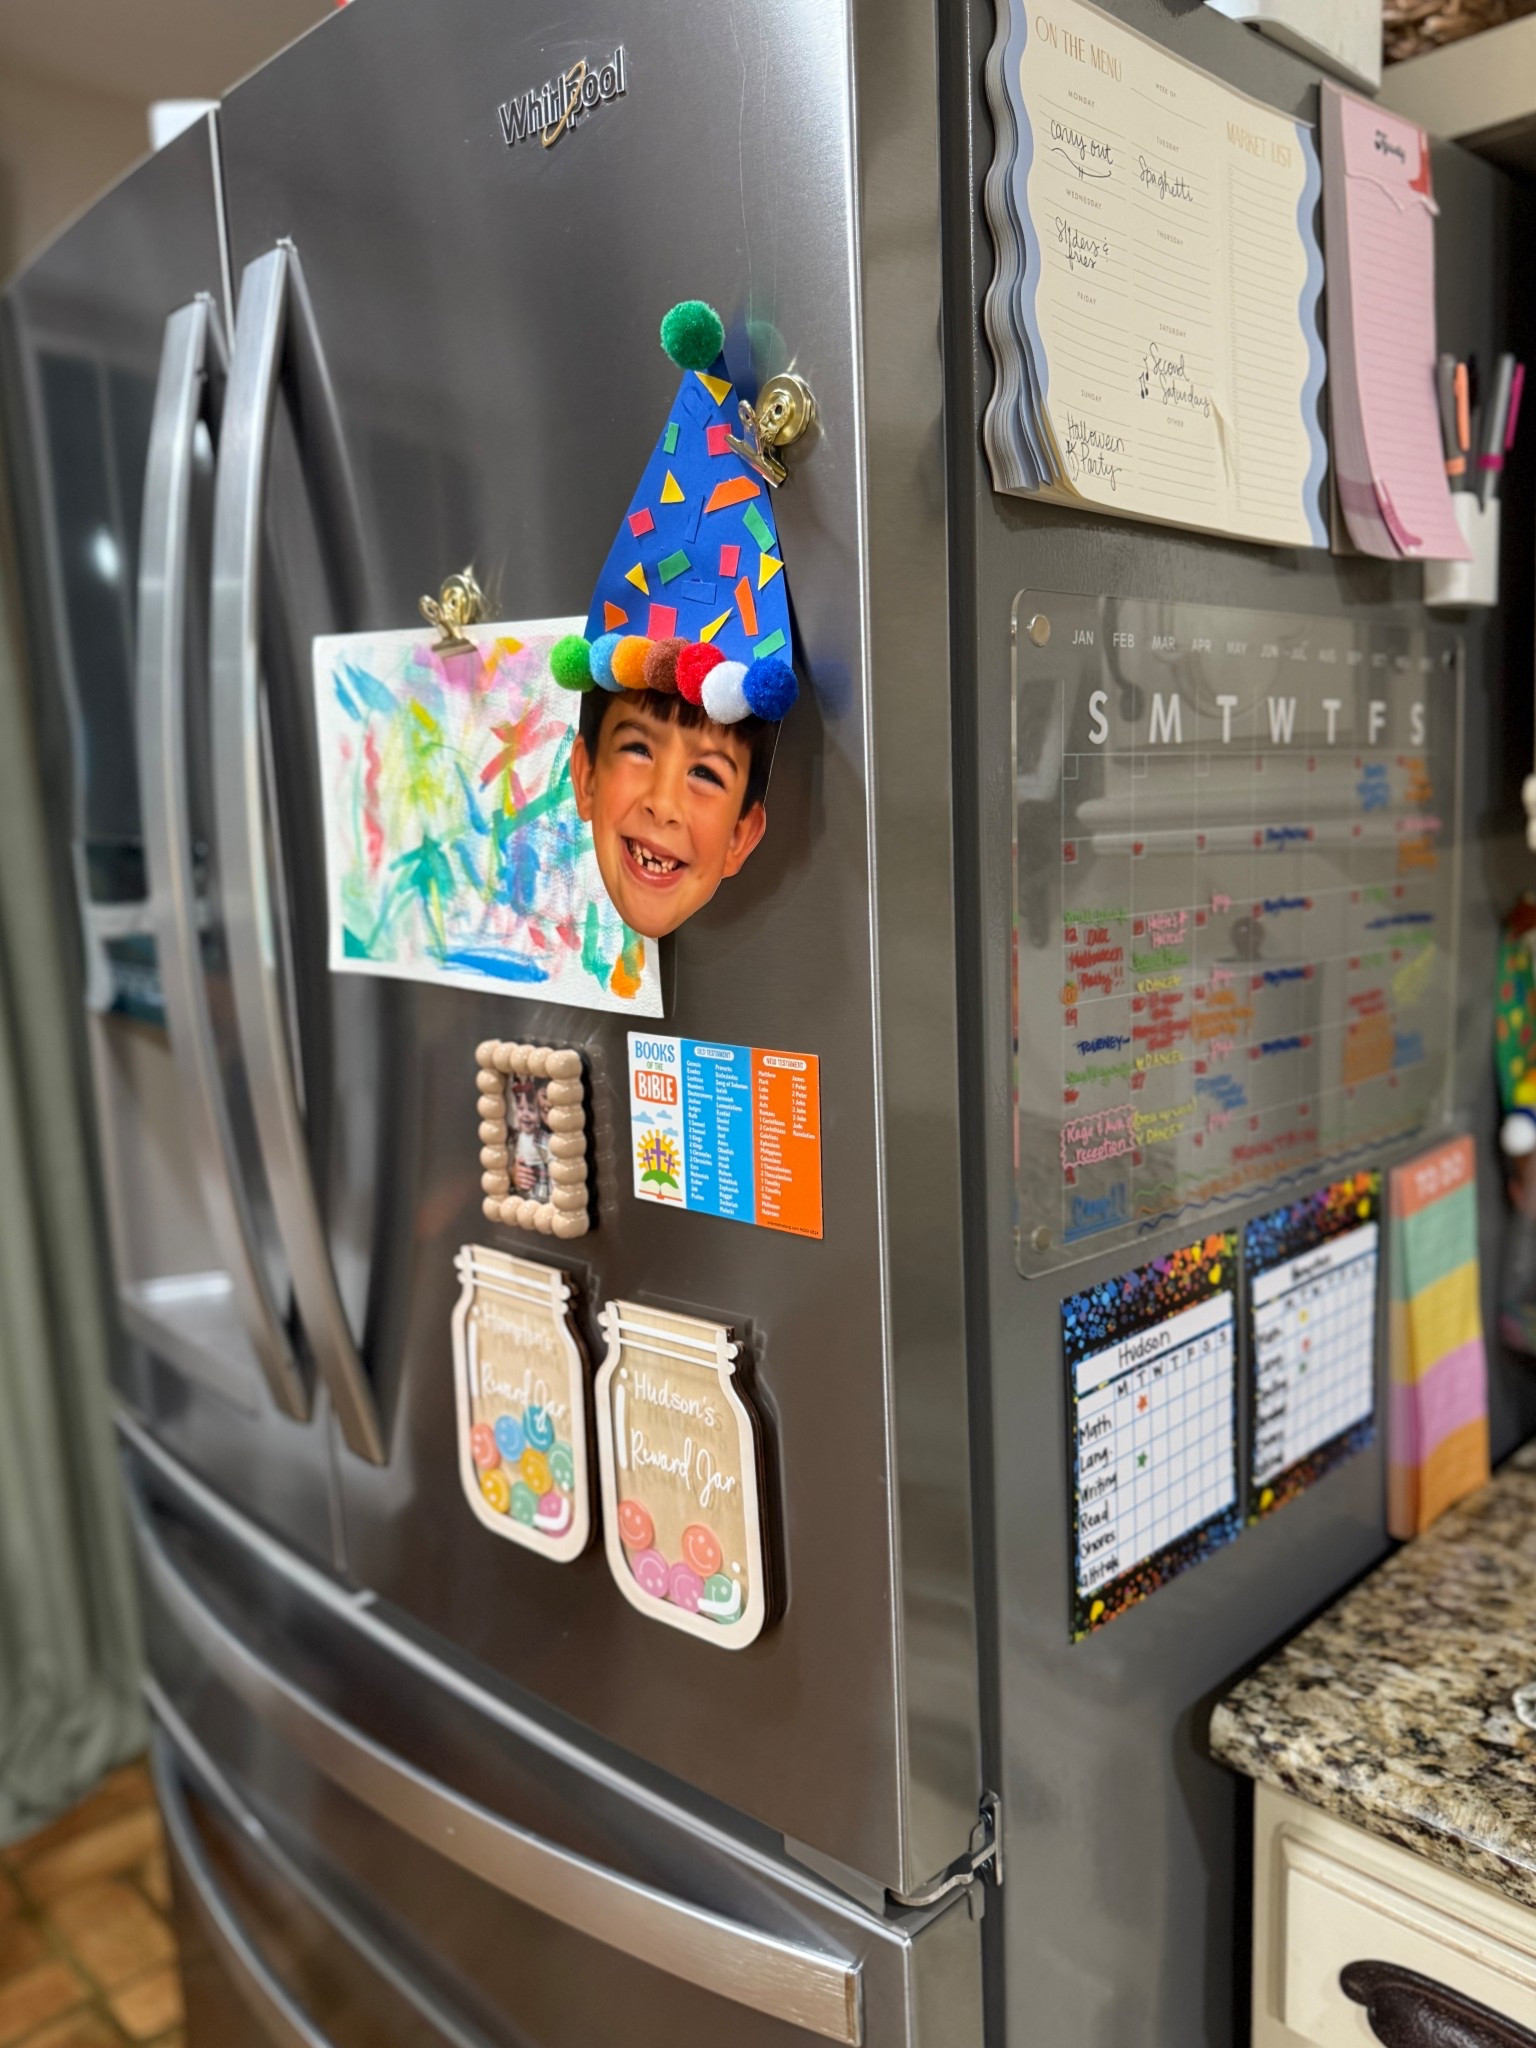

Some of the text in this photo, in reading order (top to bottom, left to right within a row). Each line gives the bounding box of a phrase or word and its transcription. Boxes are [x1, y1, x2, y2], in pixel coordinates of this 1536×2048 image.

[1035, 15, 1123, 83] ON THE MENU
[498, 45, 626, 145] Whirlpool
[1067, 90, 1095, 108] MONDAY
[1155, 83, 1168, 95] WEEK
[1091, 139, 1113, 165] out
[1156, 136, 1180, 152] TUESDAY
[1226, 121, 1293, 169] MARKET LIST
[1066, 189, 1102, 209] WEDNESDAY
[1156, 229, 1184, 246] THURSDAY
[1077, 291, 1097, 305] FRIDAY
[1159, 322, 1187, 338] SATURDAY
[1081, 389, 1102, 402] SUNDAY
[1159, 375, 1211, 418] Saturday
[1066, 411, 1125, 454] Halloween
[1166, 417, 1184, 428] OTHER
[1072, 630, 1094, 646] JAN
[1113, 633, 1135, 648] FEB
[1152, 635, 1175, 651] MAR
[1191, 639, 1212, 653] APR
[1088, 690, 1425, 746] S M T W T F S
[635, 1040, 675, 1063] BOOKS
[646, 1061, 664, 1071] OF THE
[638, 1072, 675, 1103] BIBLE
[1118, 1330, 1171, 1369] Hudson
[1117, 1380, 1129, 1397] M
[1137, 1370, 1147, 1387] T
[1153, 1362, 1163, 1377] W
[1171, 1356, 1180, 1371] T
[532, 1379, 567, 1432] Jar
[634, 1370, 715, 1427] Hudson's
[1079, 1414, 1112, 1446] Math
[631, 1428, 736, 1507] Reward Jar
[1080, 1500, 1110, 1534] Read
